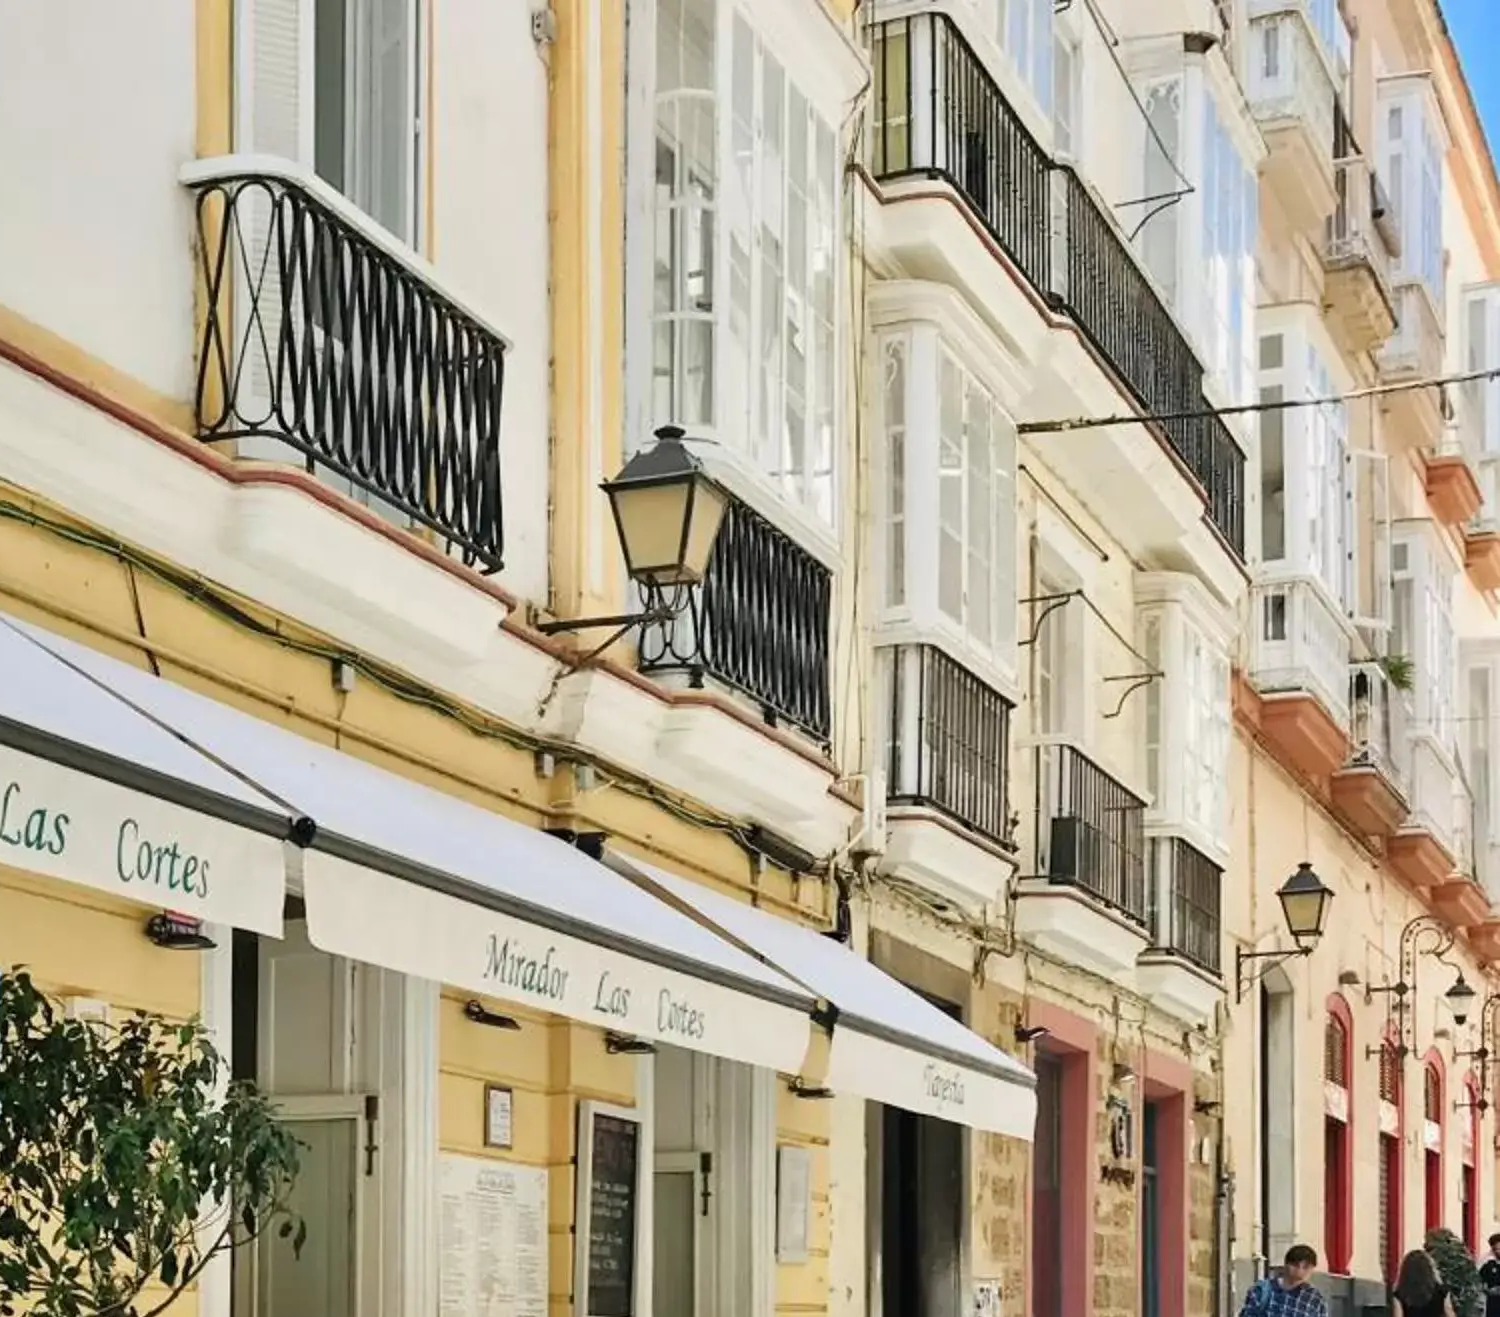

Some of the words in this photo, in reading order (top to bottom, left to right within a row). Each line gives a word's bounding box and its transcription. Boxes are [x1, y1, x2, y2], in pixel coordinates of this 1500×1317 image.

[116, 818, 211, 899] Cortes
[483, 933, 569, 1001] Mirador
[593, 970, 631, 1018] Las
[656, 988, 705, 1039] Cortes
